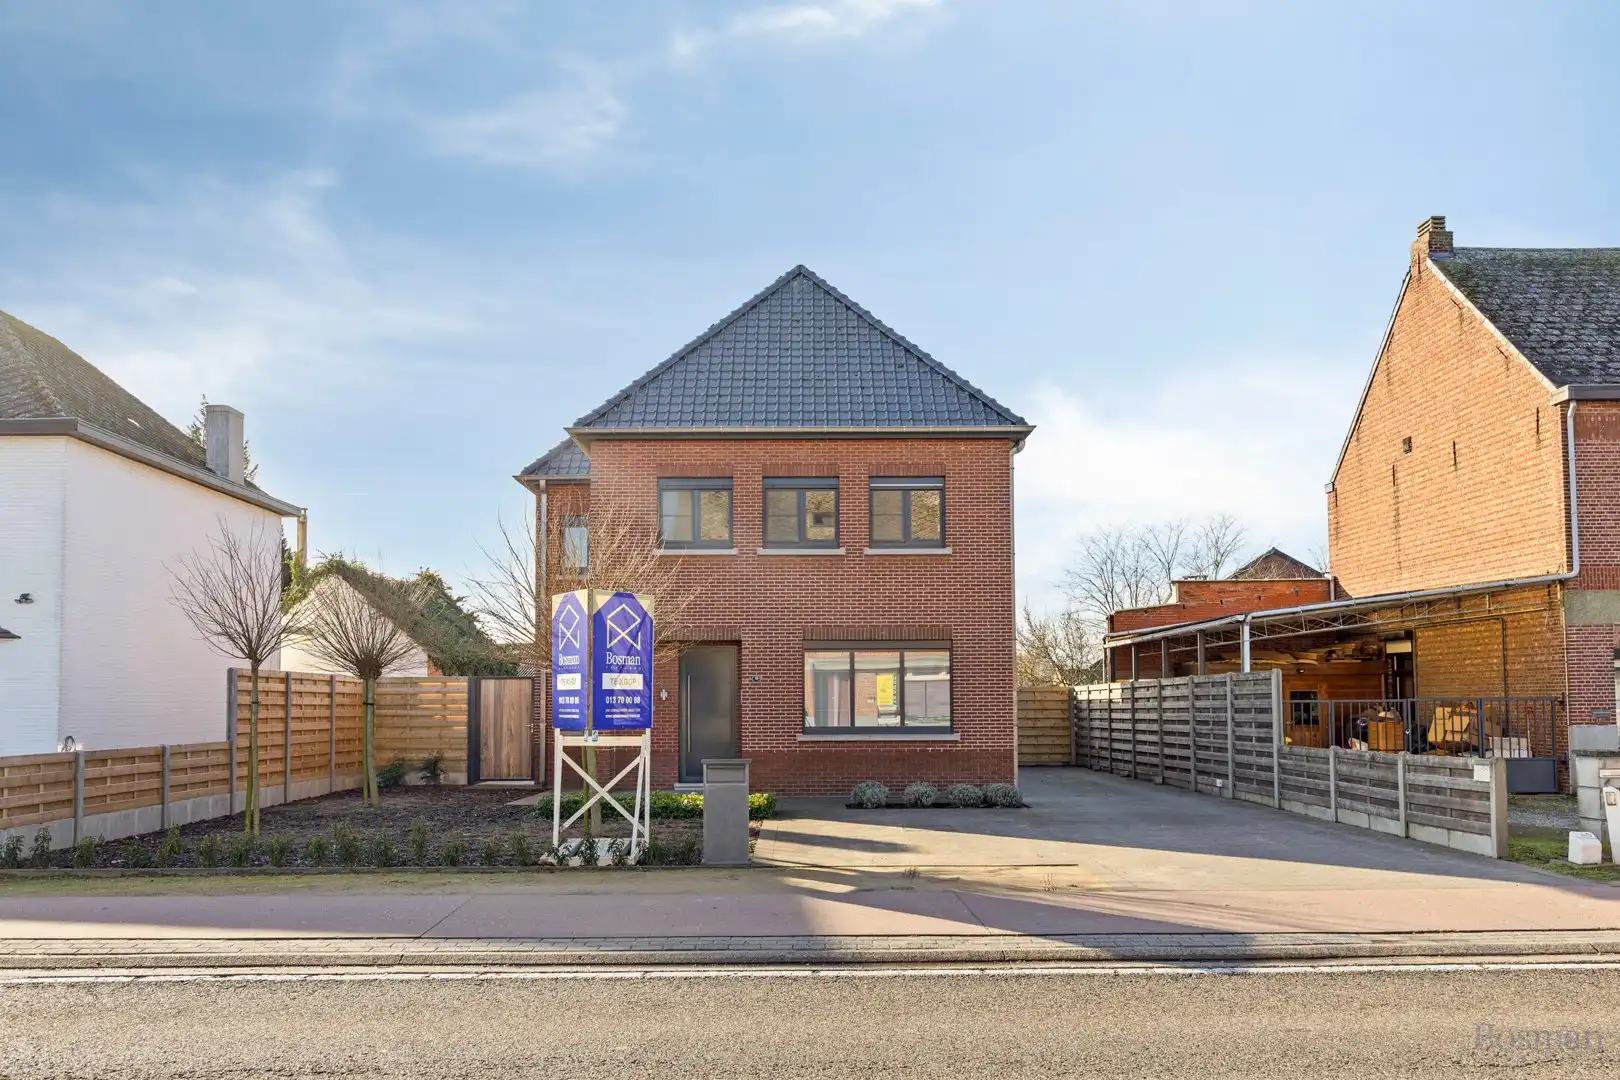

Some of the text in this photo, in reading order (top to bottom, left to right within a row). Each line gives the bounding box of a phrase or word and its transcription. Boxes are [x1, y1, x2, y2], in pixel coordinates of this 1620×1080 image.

[558, 654, 579, 665] Bosman
[606, 652, 640, 665] Bosman
[610, 677, 636, 686] TE KOOP
